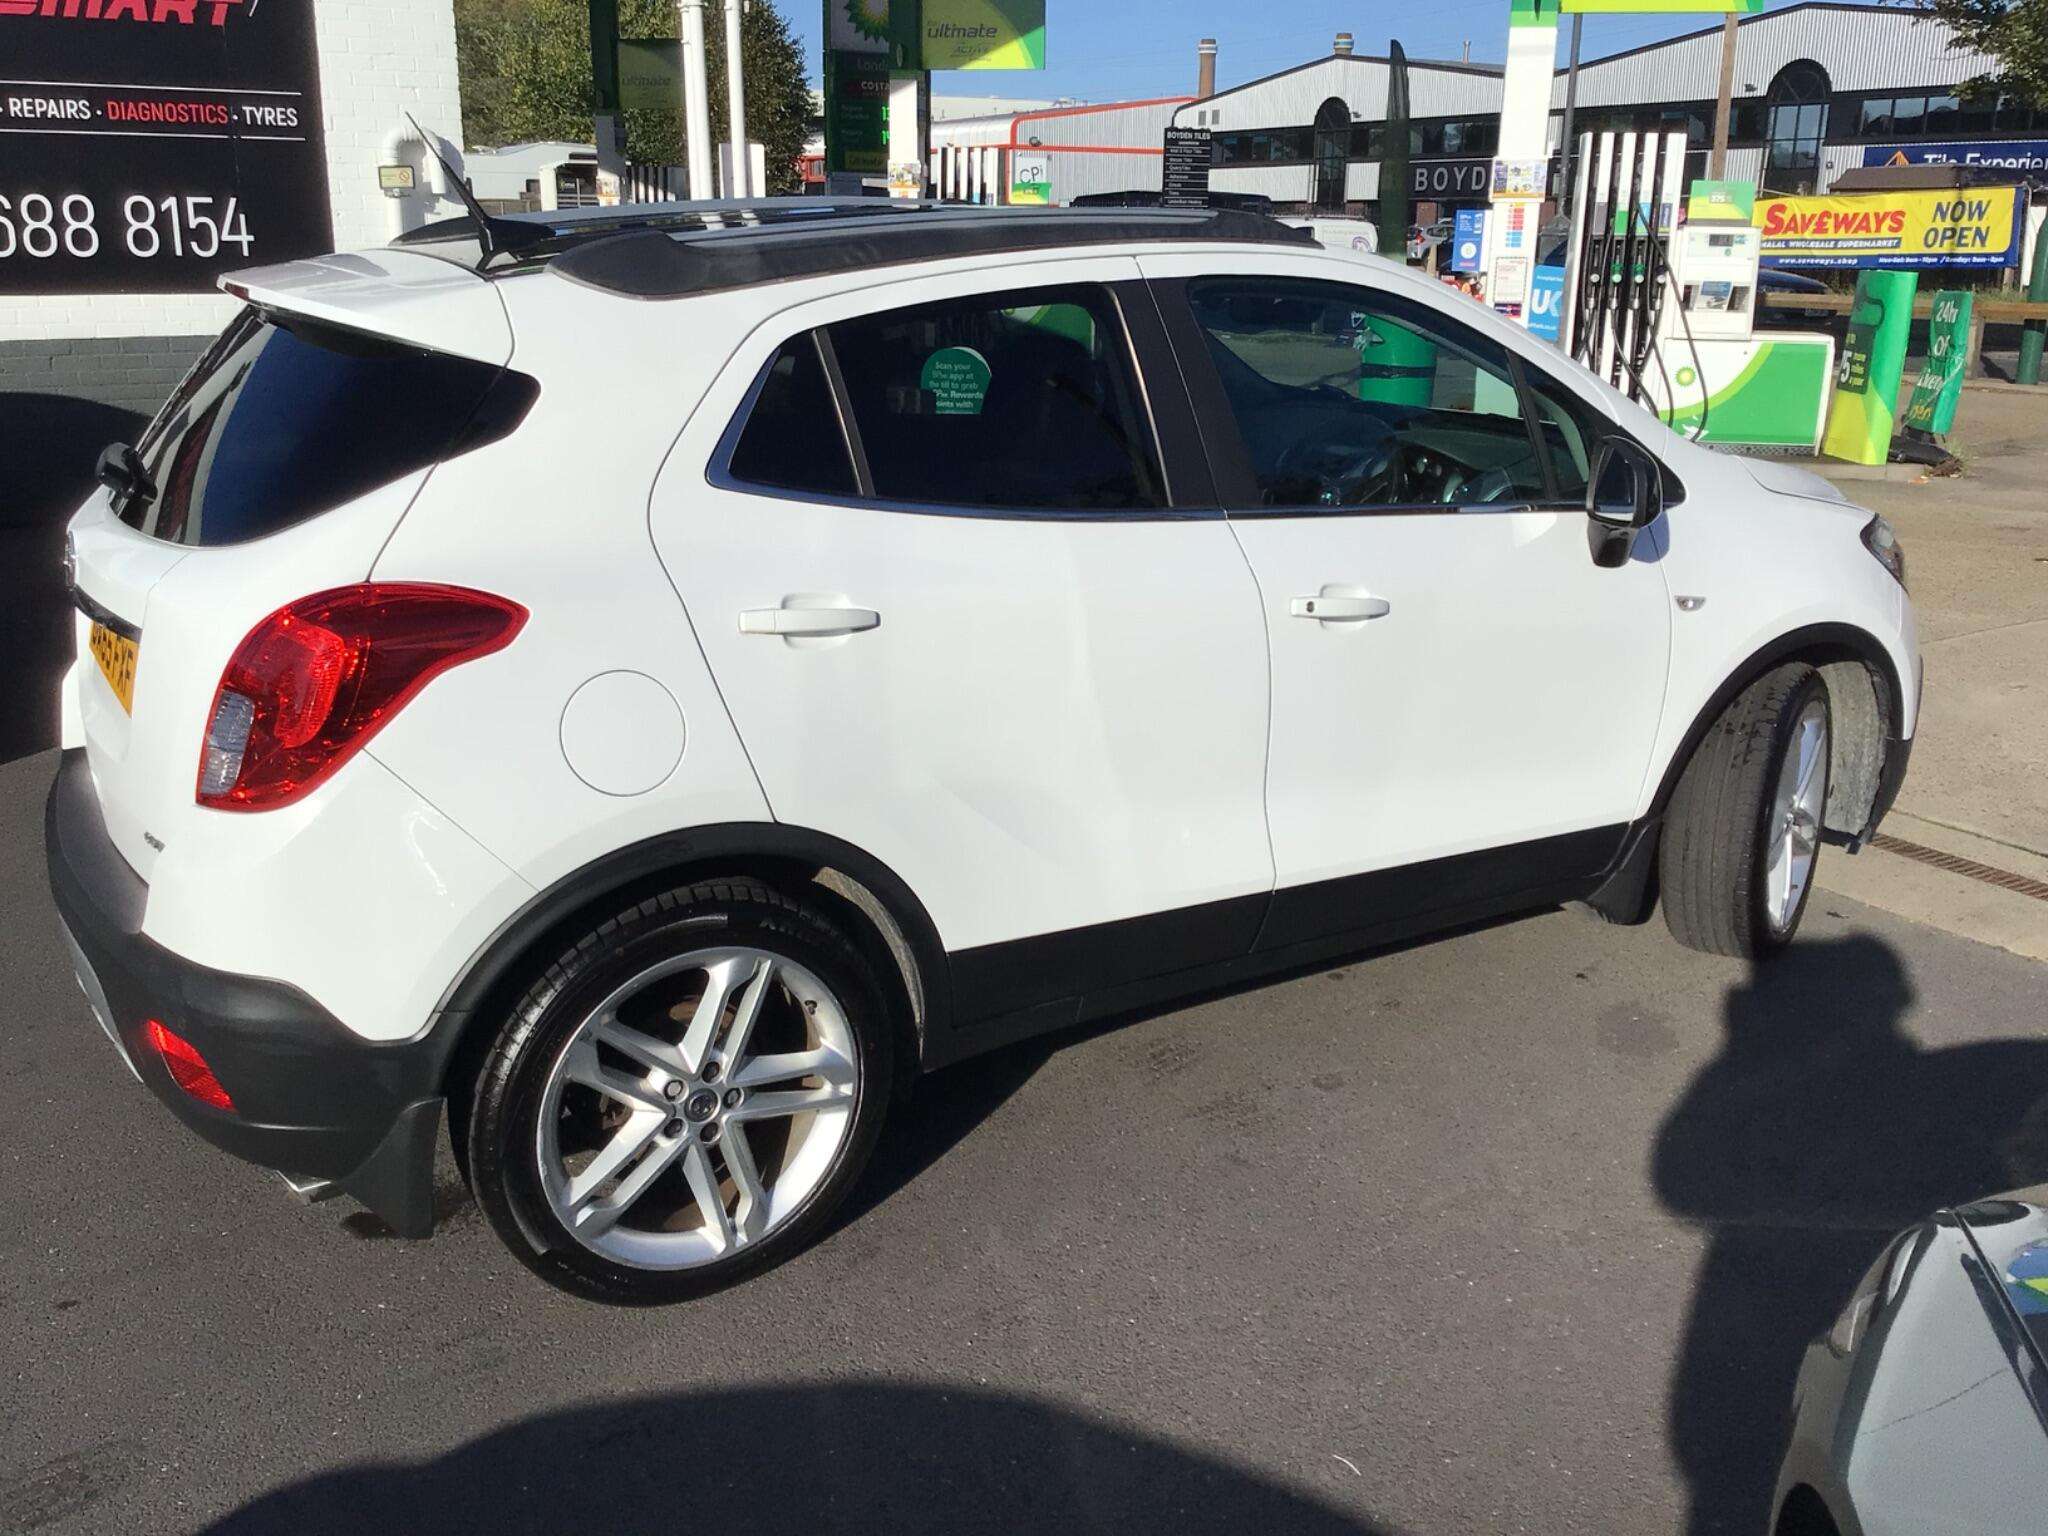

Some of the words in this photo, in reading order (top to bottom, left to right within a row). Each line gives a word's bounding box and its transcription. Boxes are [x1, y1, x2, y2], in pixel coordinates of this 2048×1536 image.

[927, 22, 998, 39] ultimate
[9, 97, 91, 120] REPAIRS
[106, 100, 229, 124] DIAGNOSTICS
[242, 106, 298, 127] TYRES
[1414, 166, 1487, 192] BOYD
[1932, 199, 1991, 223] NOW
[124, 195, 255, 258] 8154
[1923, 225, 1991, 248] OPEN
[1788, 239, 1835, 248] WHOLESALE
[1837, 239, 1899, 248] SUPERMARKET
[1532, 288, 1564, 317] UK
[1935, 299, 1960, 324] 24hr
[950, 390, 984, 399] Rewards
